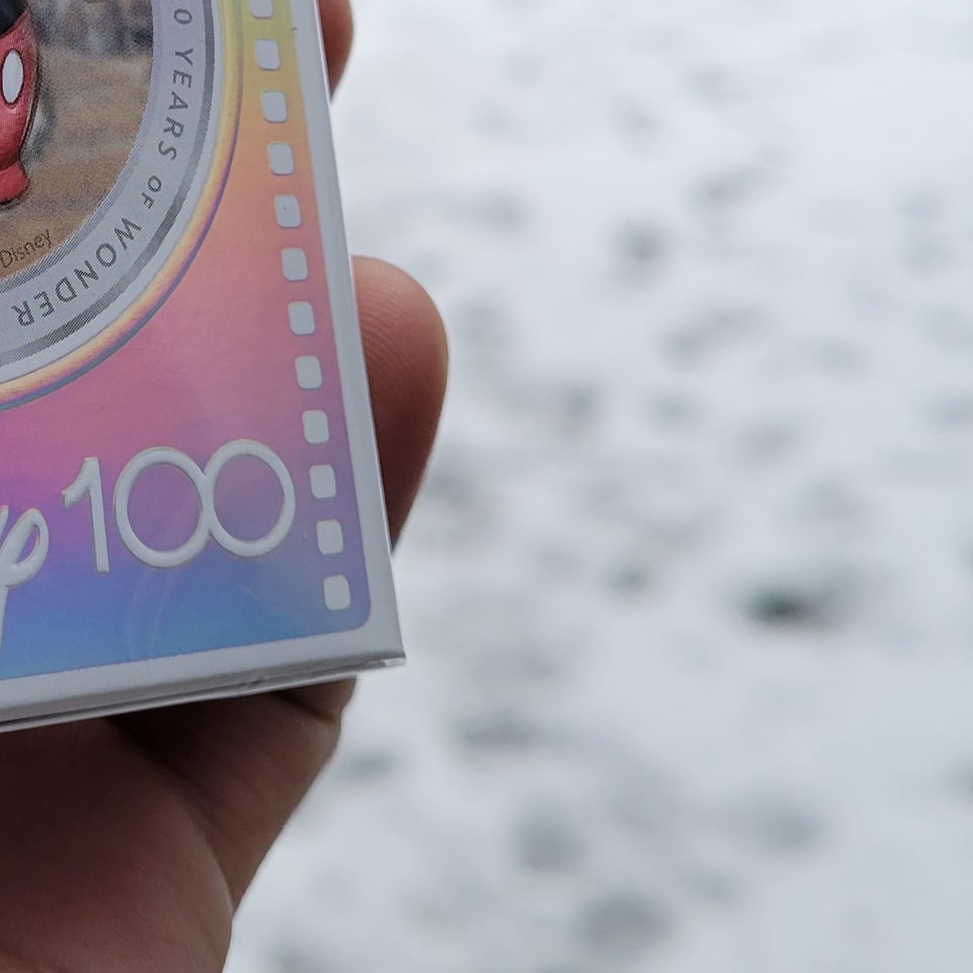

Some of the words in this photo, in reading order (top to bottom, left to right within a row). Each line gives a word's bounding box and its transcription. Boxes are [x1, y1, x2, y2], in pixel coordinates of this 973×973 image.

[157, 47, 194, 161] YEARS
[140, 174, 163, 210] OF
[10, 216, 143, 327] WONDER
[61, 438, 296, 574] 100
